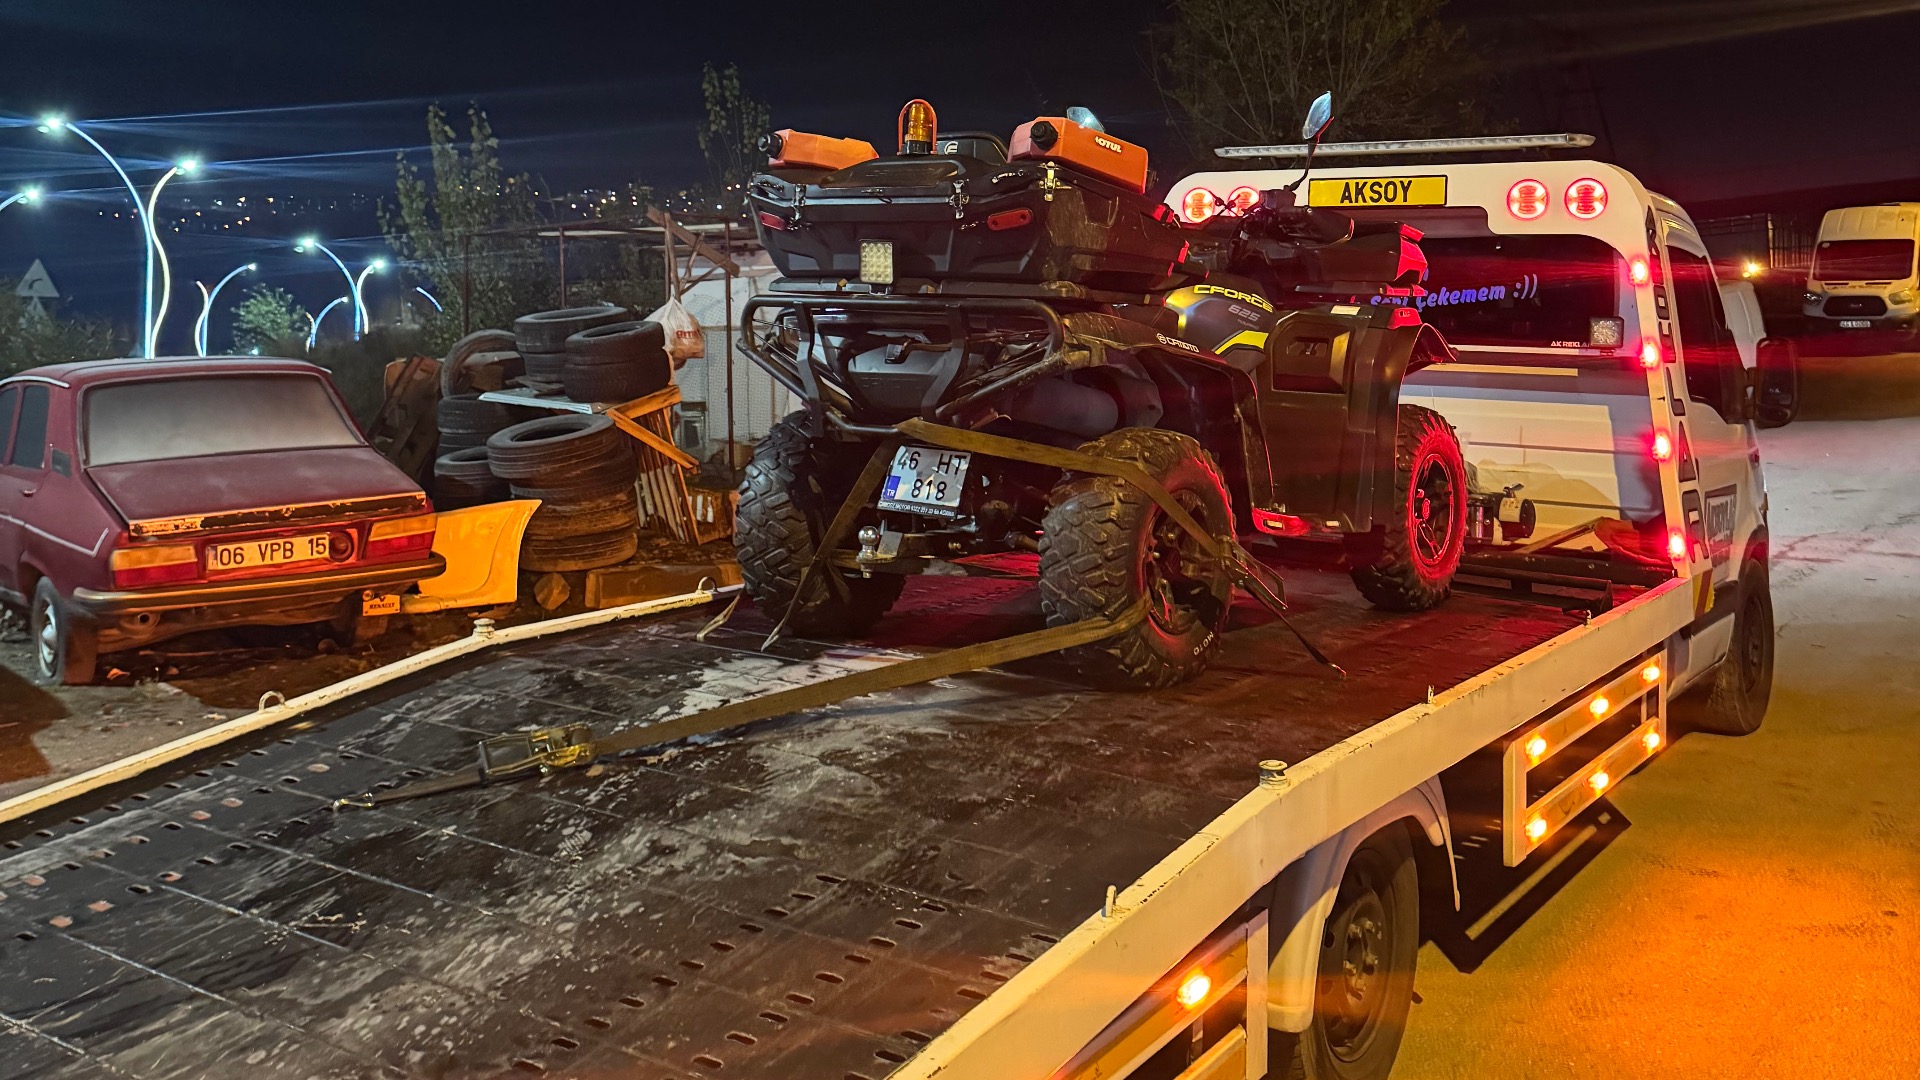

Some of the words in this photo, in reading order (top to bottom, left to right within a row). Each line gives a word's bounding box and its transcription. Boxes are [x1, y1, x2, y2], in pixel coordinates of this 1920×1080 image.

[1340, 180, 1413, 204] AKSOY
[1193, 284, 1274, 313] CFORCE
[1228, 304, 1260, 321] 625
[897, 451, 921, 470] 46
[936, 453, 967, 475] HT
[911, 479, 947, 500] 818
[219, 547, 245, 566] 06
[258, 541, 294, 562] VPB
[308, 537, 327, 556] 15
